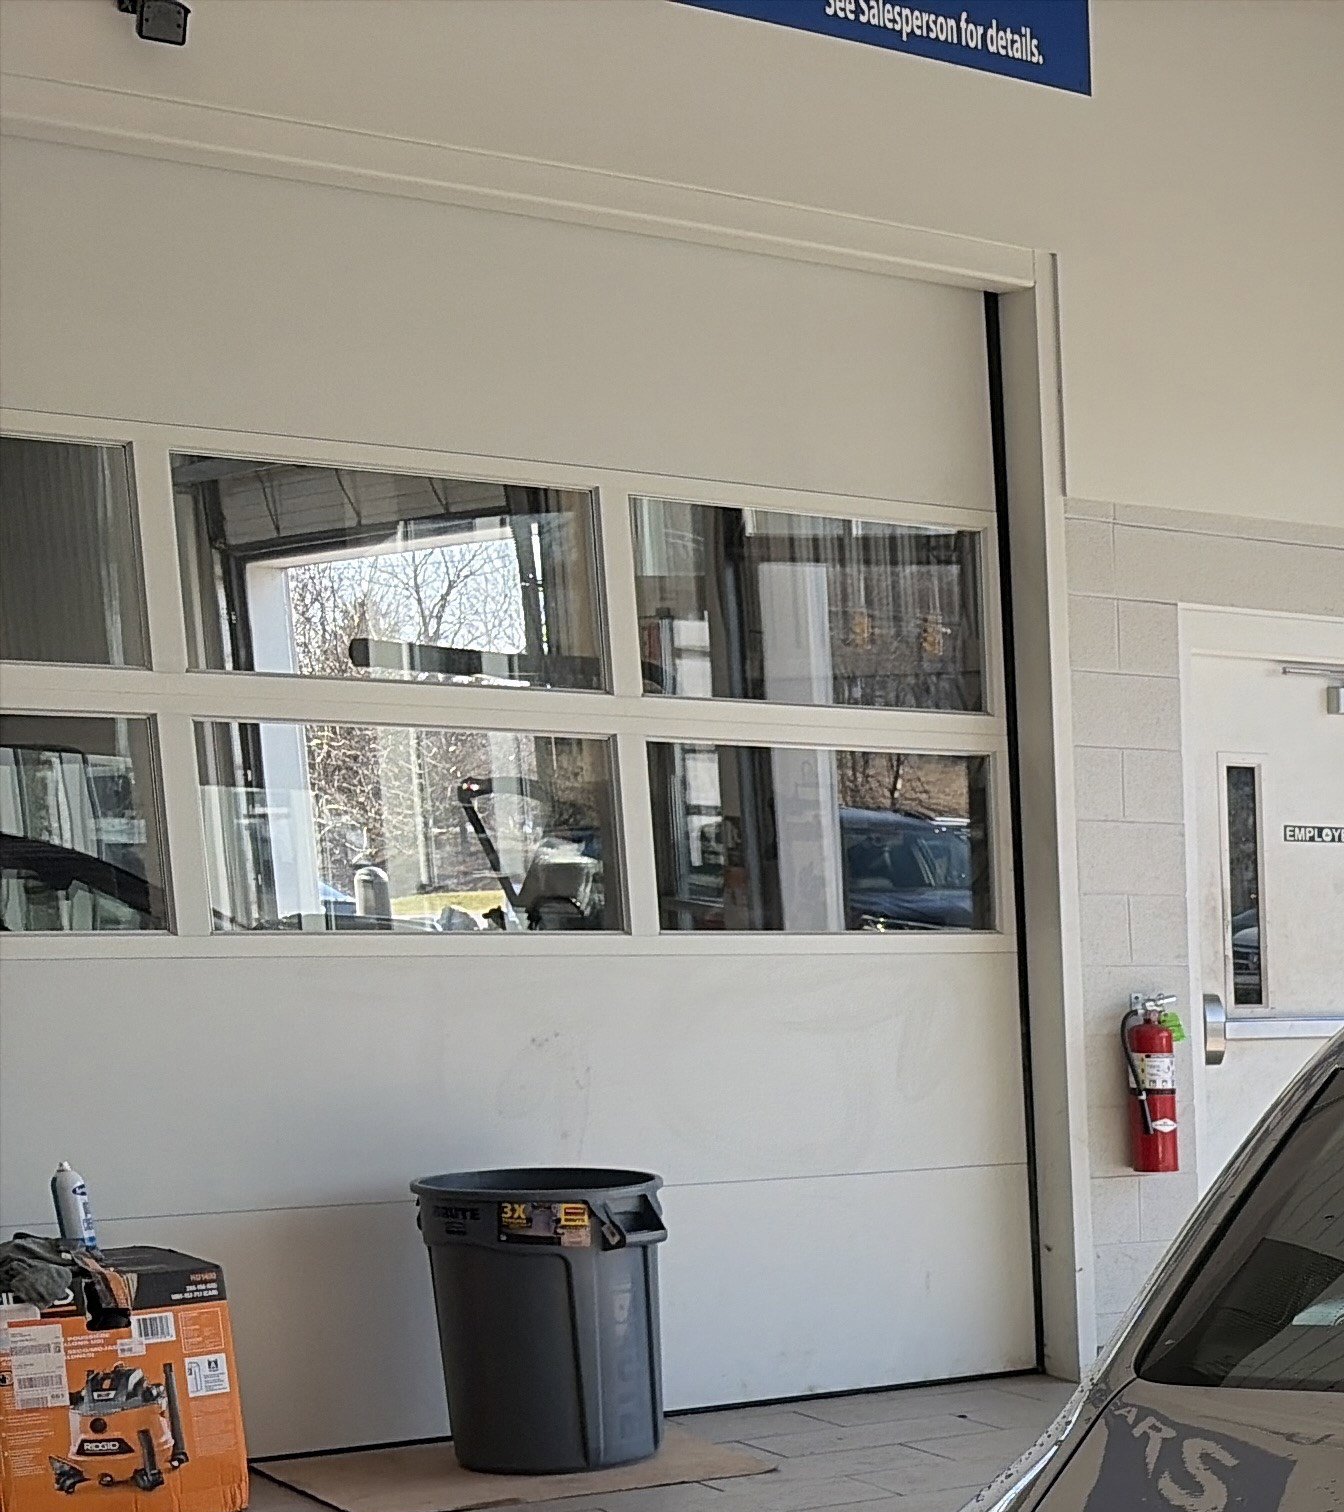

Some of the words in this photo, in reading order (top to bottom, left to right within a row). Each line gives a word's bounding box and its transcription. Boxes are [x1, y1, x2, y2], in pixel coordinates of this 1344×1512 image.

[859, 0, 957, 44] Salesperson
[959, 11, 983, 50] for
[986, 19, 1044, 65] details.
[502, 1203, 526, 1219] 3X
[84, 1441, 120, 1451] RIDGID
